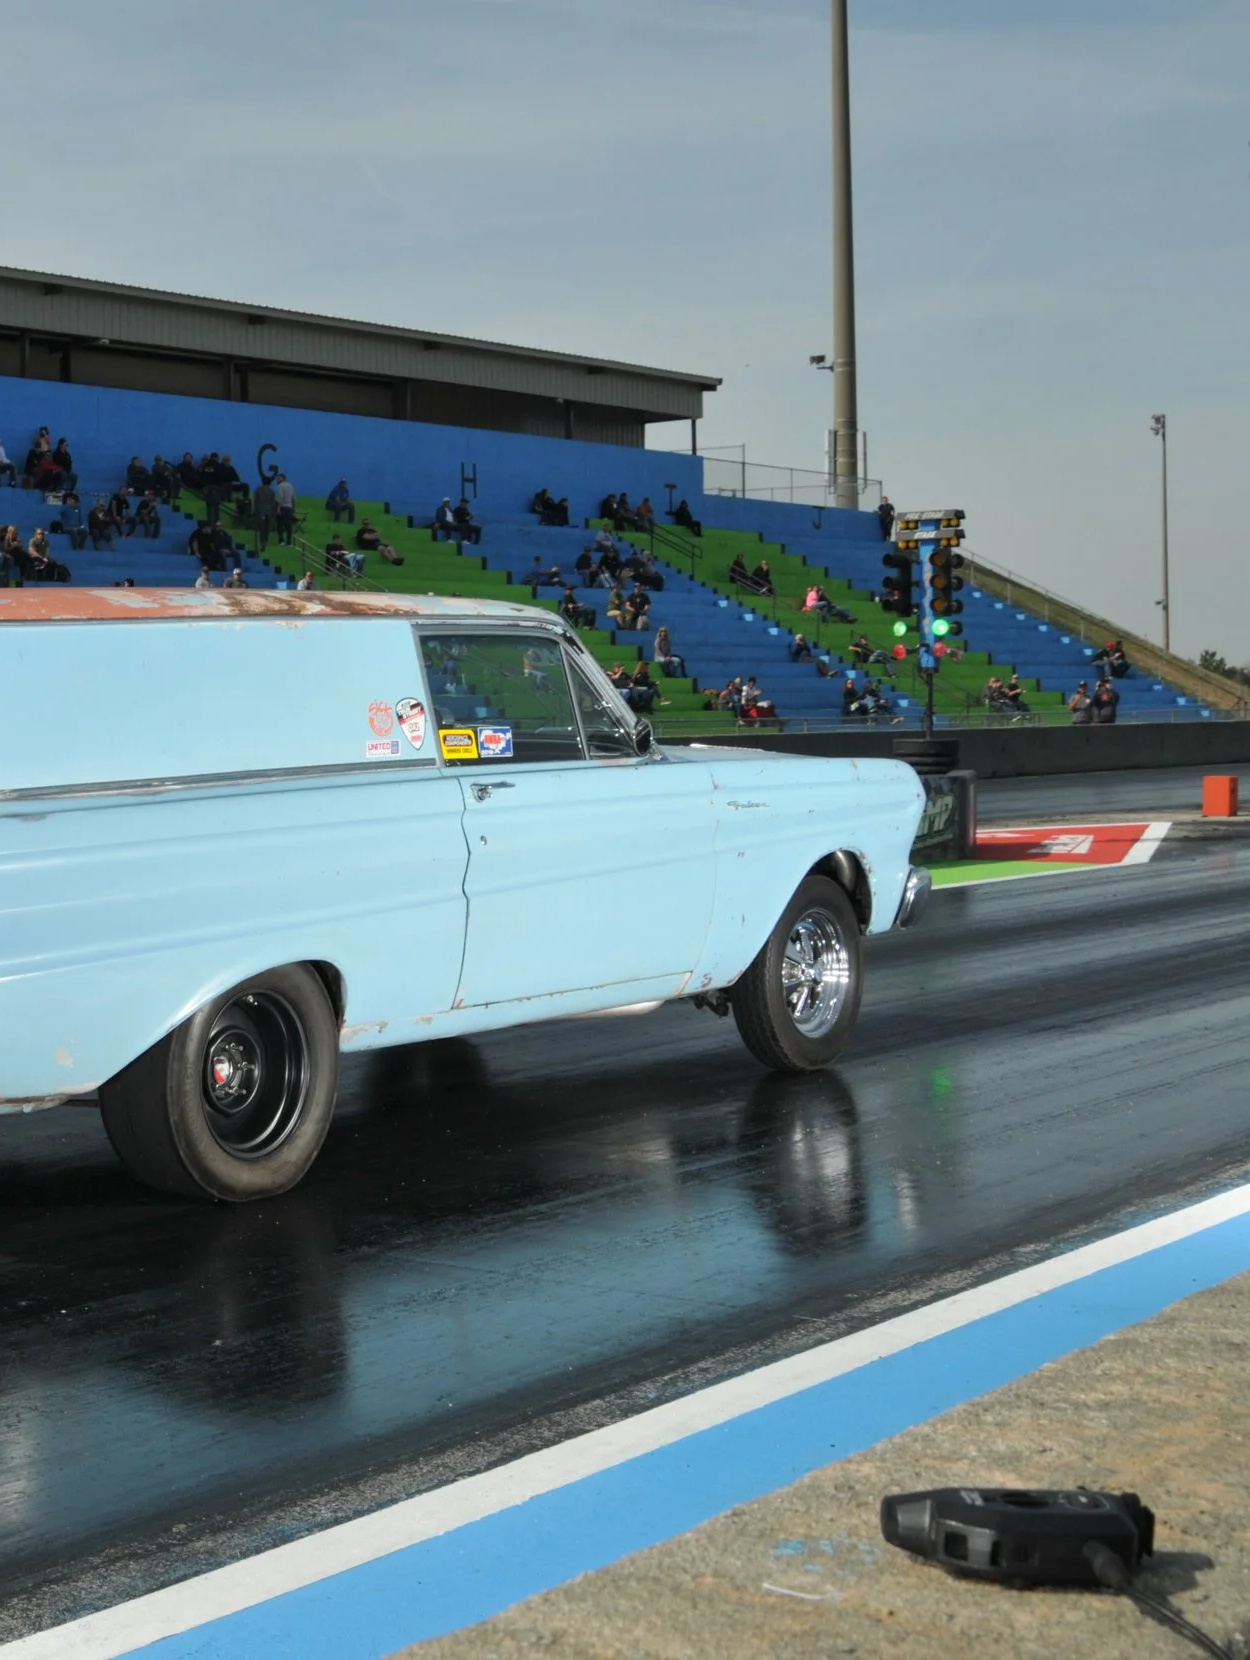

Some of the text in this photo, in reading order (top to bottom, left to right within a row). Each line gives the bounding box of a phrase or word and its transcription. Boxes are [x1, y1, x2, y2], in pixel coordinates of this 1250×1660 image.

[257, 443, 278, 484] G
[461, 462, 477, 498] H
[368, 743, 391, 751] UNITED
